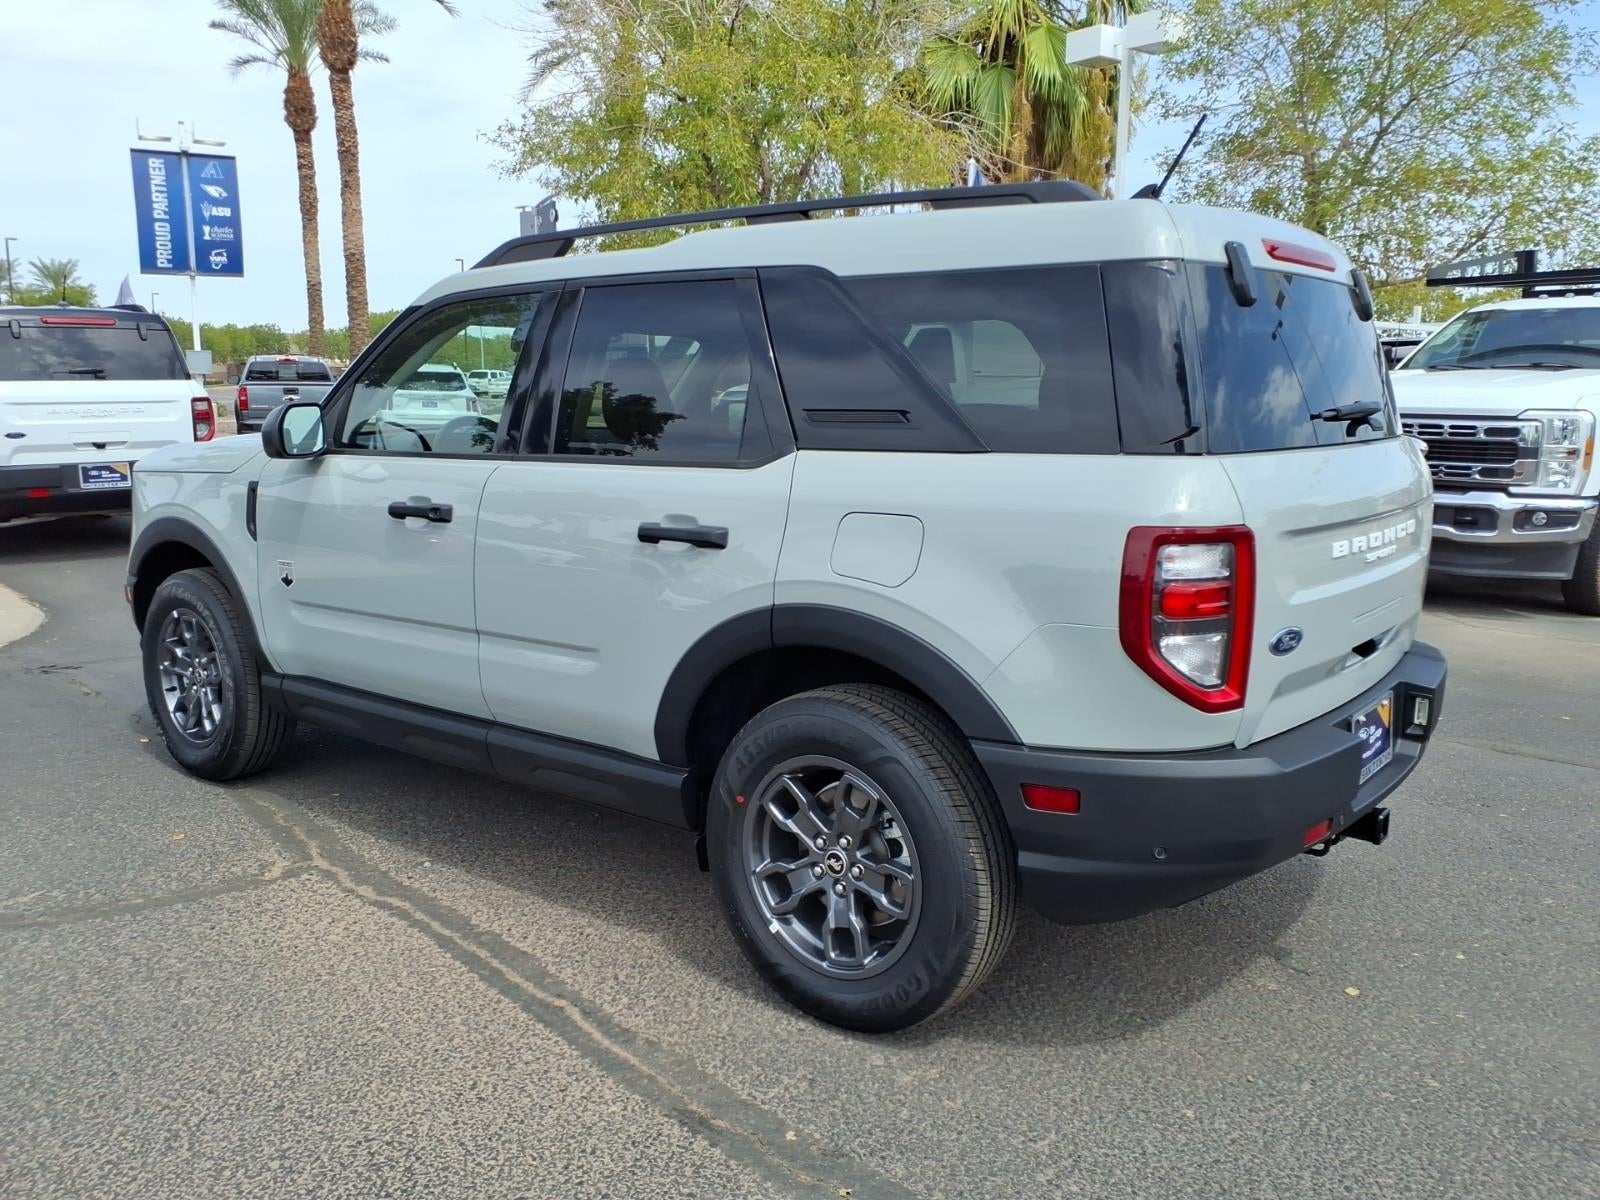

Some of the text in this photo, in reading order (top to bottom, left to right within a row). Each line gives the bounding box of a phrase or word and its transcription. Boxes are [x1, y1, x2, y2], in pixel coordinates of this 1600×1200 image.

[148, 157, 173, 268] PROUD PARTNER
[211, 206, 231, 216] ASU
[1331, 518, 1416, 559] BRONCO
[1365, 544, 1398, 563] SPORT
